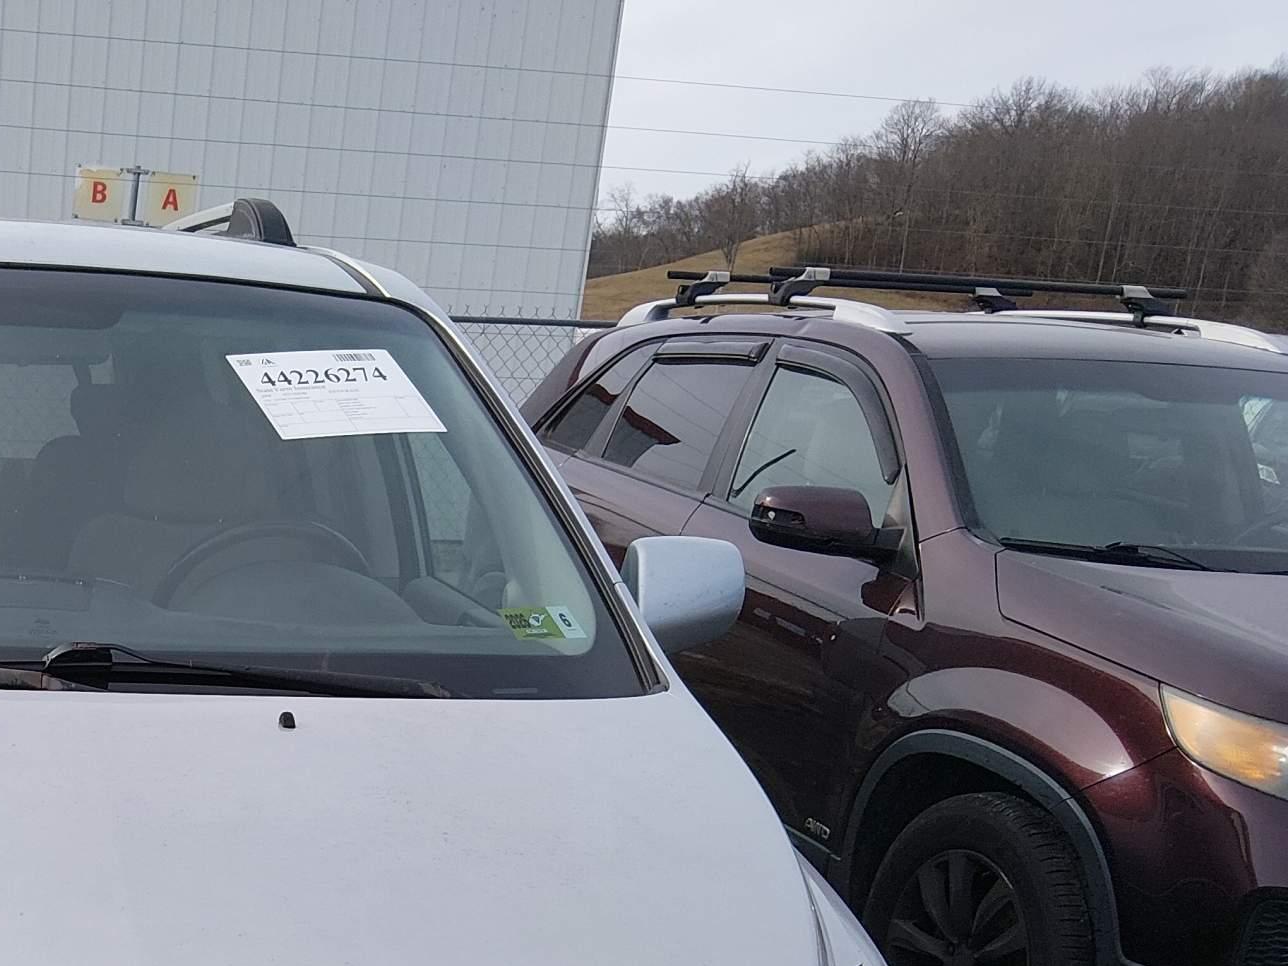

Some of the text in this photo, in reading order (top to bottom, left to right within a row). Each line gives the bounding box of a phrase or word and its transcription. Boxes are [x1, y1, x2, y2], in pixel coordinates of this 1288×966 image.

[91, 181, 107, 203] B
[161, 188, 179, 211] A
[260, 366, 388, 386] 44226274
[558, 612, 572, 628] 6
